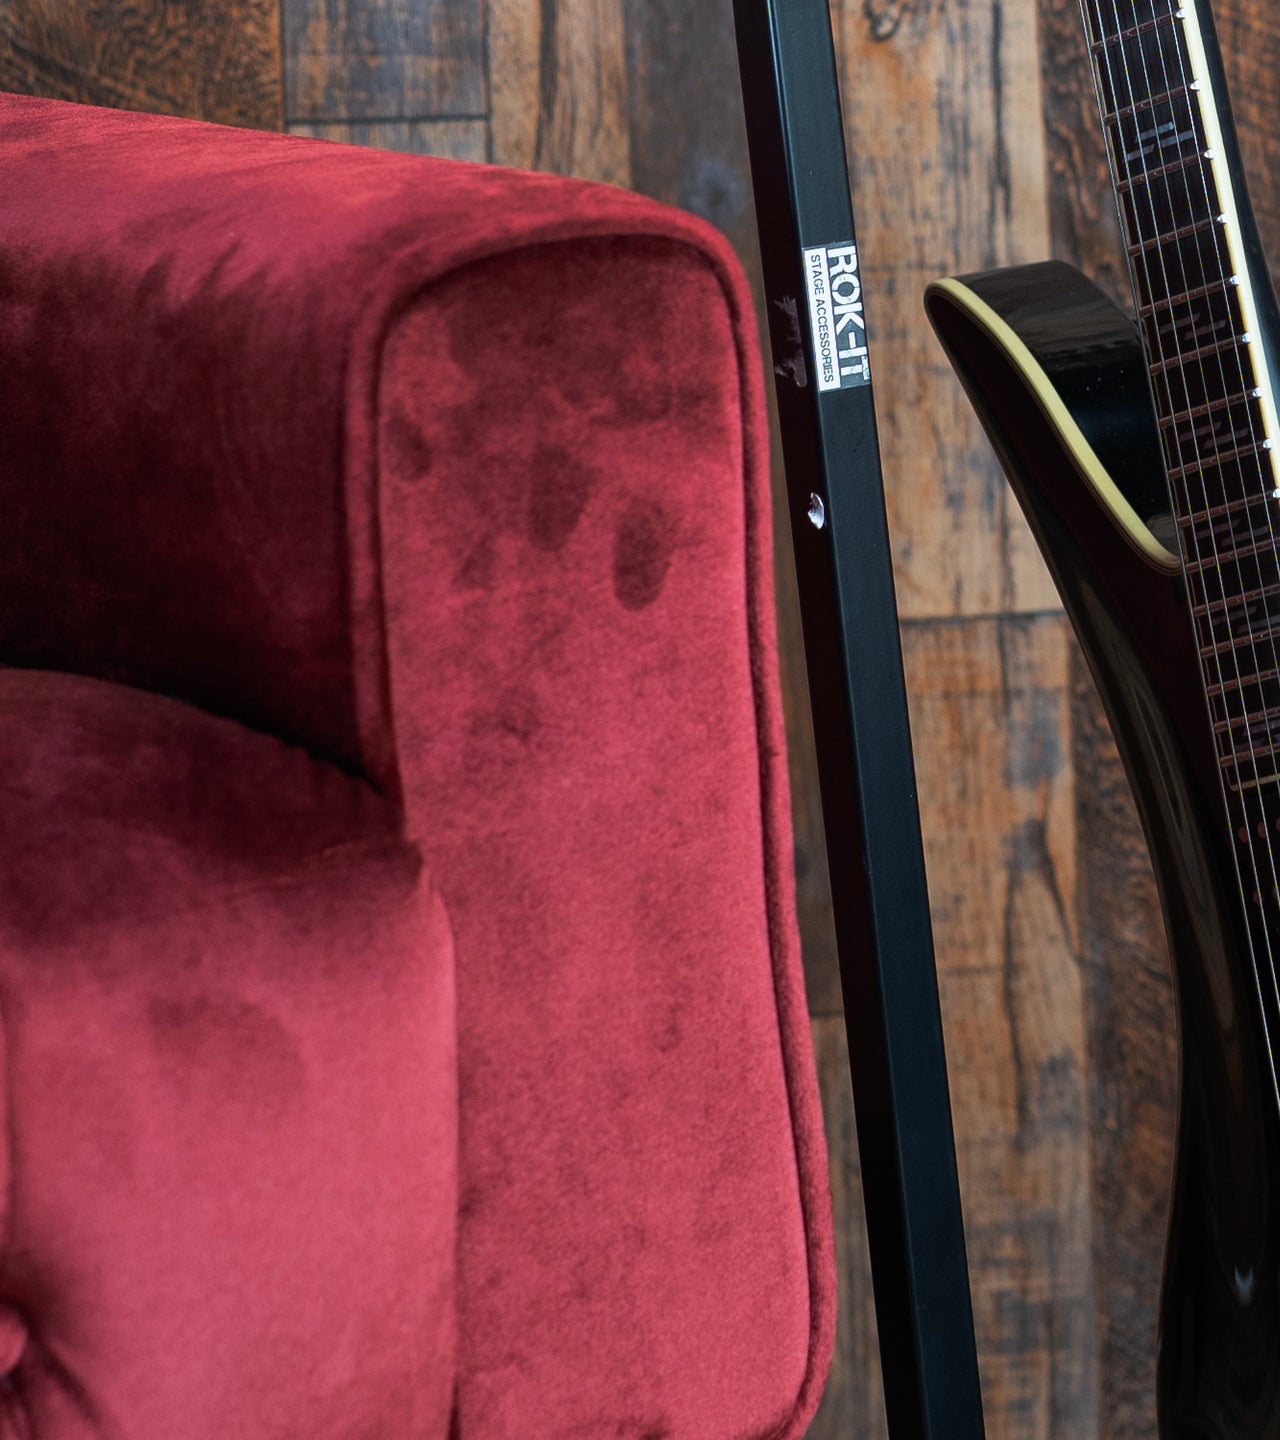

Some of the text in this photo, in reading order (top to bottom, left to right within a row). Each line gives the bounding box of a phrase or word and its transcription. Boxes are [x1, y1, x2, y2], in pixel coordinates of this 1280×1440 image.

[810, 254, 834, 383] STAGE ACCESSORIES
[827, 245, 870, 381] ROK-IT
